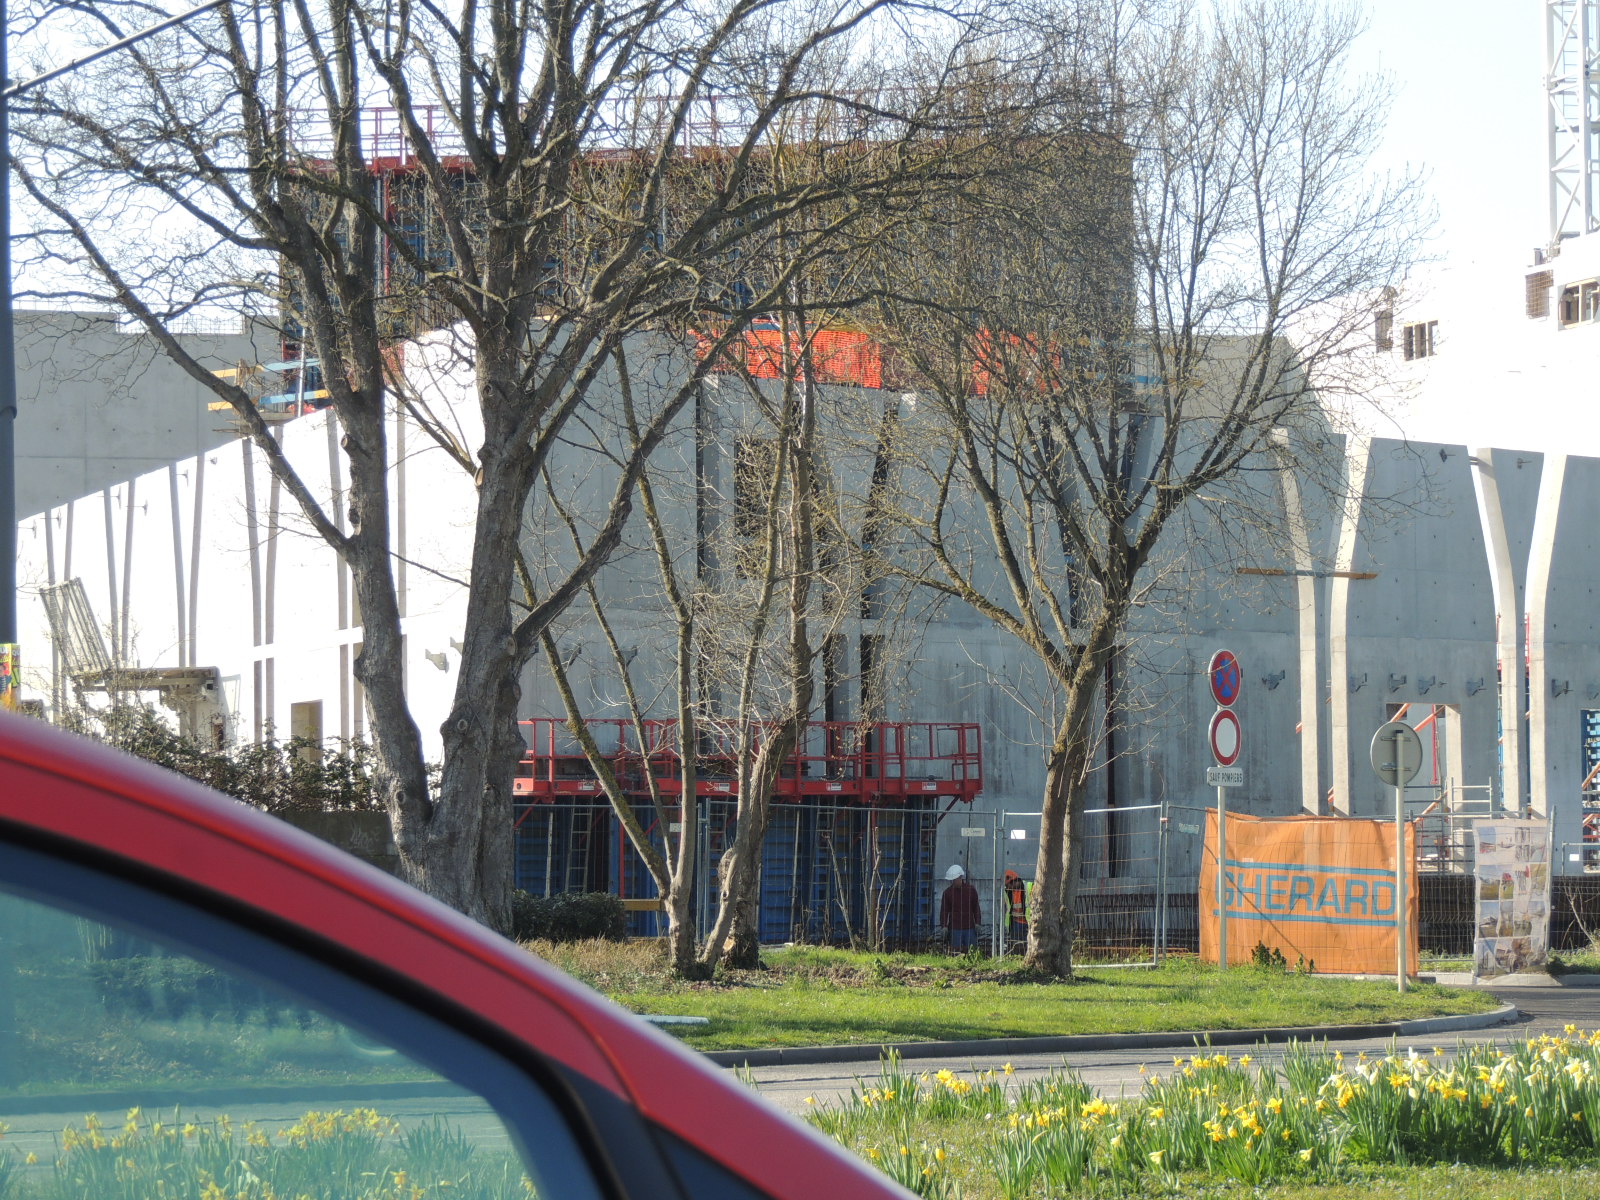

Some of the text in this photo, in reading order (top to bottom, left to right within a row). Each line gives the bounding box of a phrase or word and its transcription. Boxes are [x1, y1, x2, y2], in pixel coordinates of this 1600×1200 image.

[1209, 772, 1243, 783] SAUF POMPIERS
[1214, 871, 1408, 916] GHERARD
